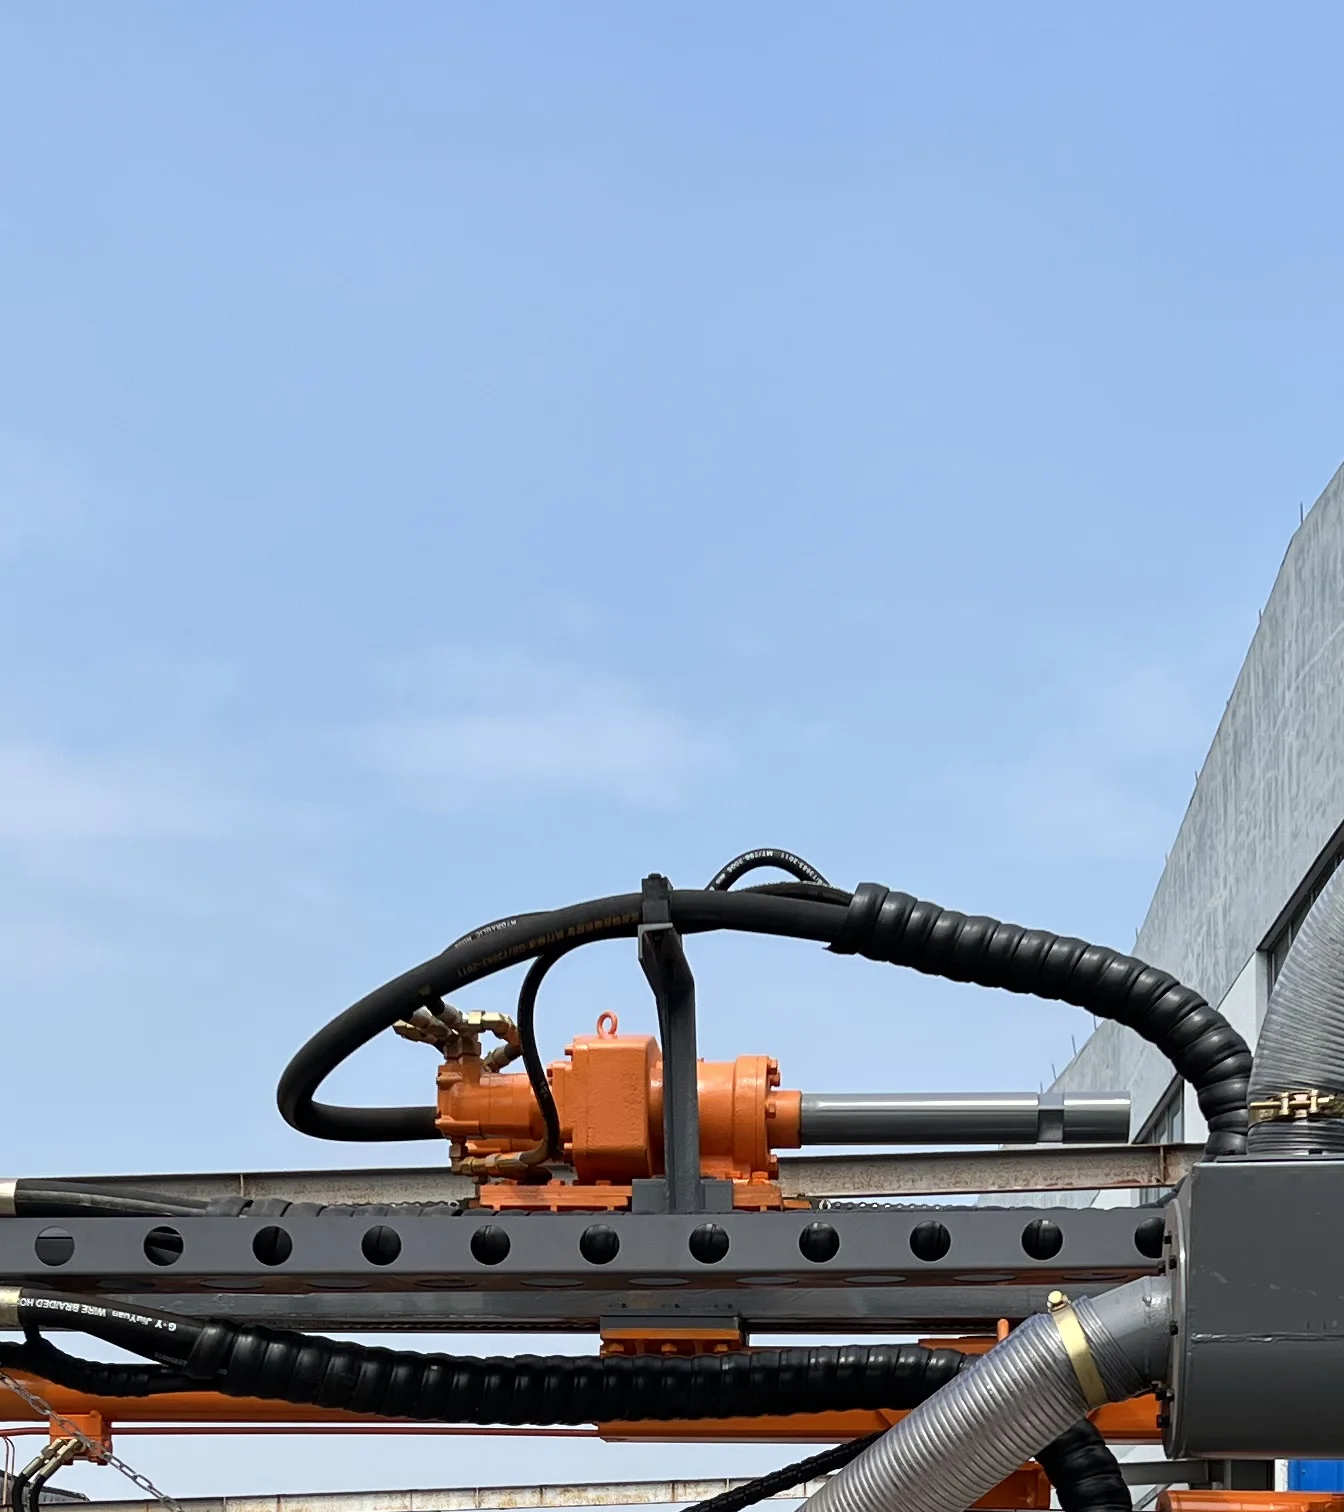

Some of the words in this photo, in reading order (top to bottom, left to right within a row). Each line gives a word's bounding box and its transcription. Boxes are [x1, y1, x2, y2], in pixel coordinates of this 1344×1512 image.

[35, 1298, 80, 1313] BRAIDED
[81, 1304, 107, 1317] WIRE
[111, 1310, 153, 1326] JiuYuan
